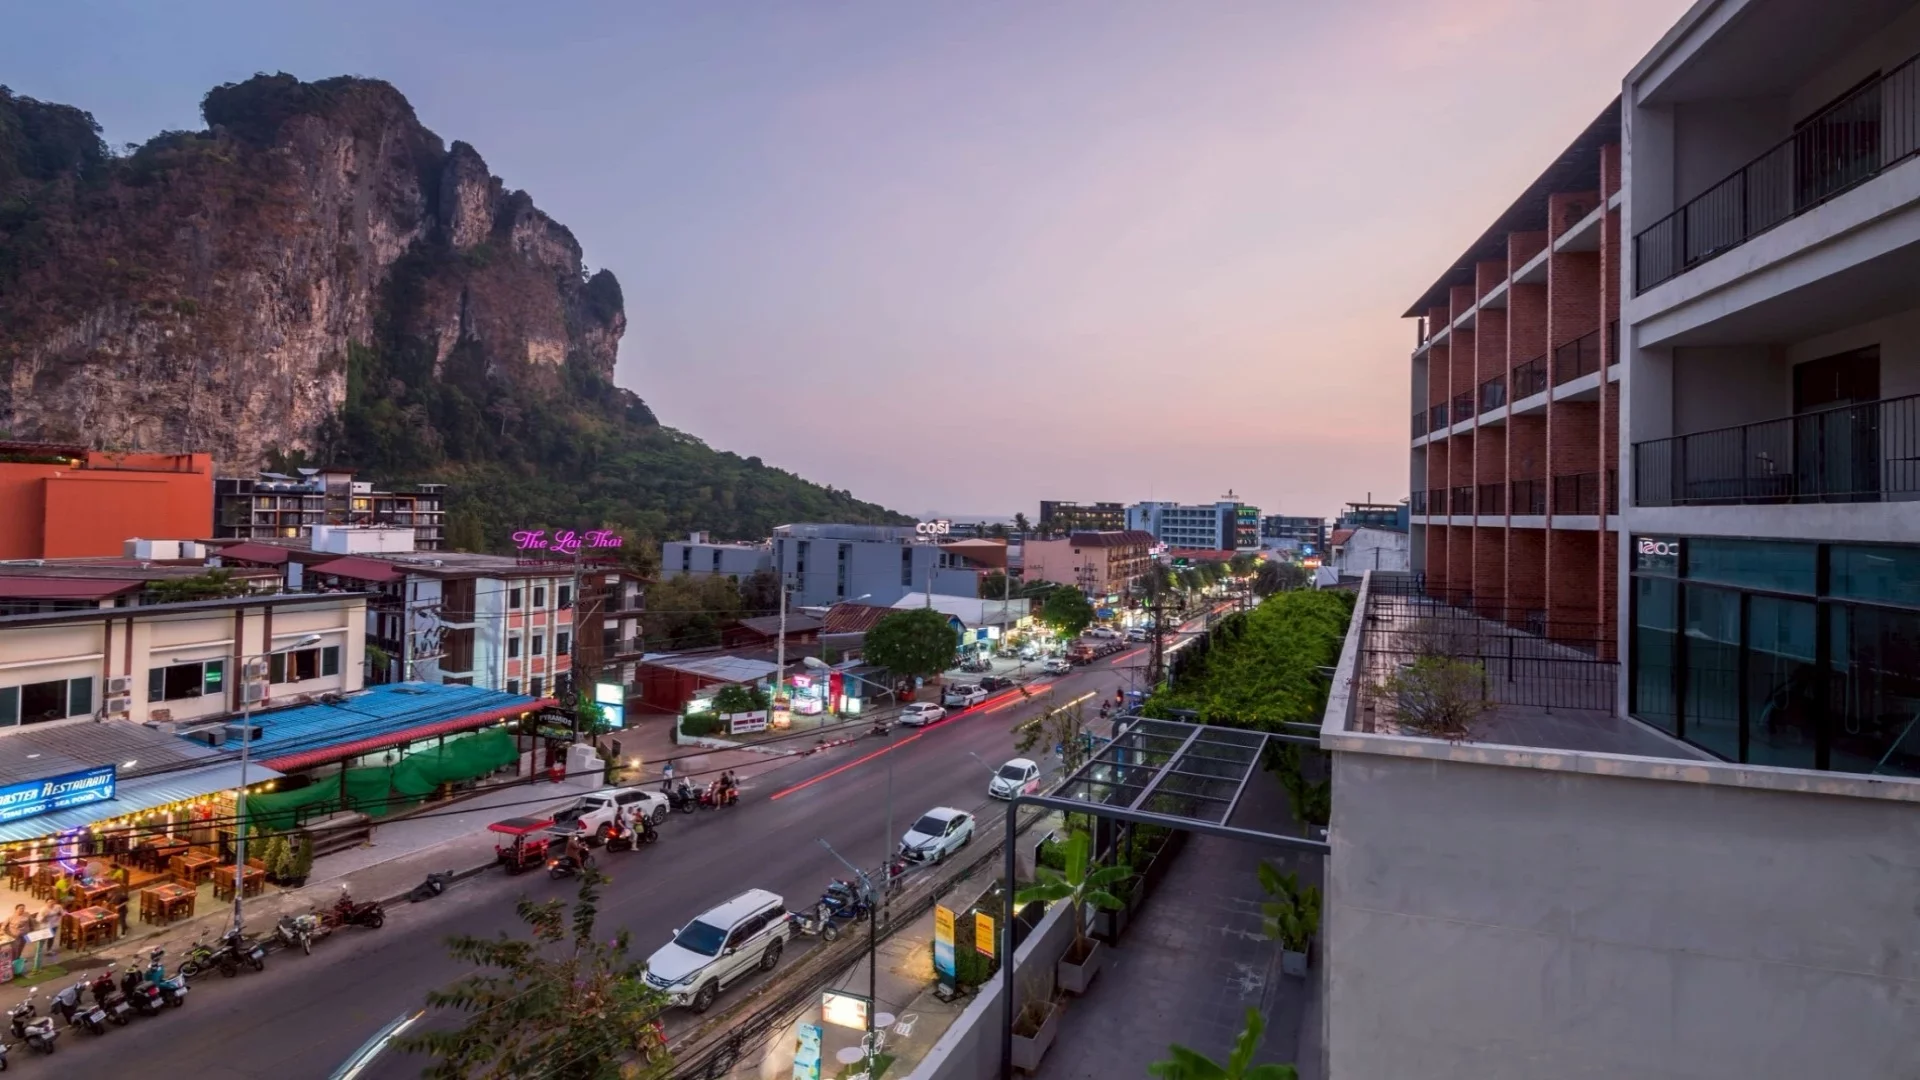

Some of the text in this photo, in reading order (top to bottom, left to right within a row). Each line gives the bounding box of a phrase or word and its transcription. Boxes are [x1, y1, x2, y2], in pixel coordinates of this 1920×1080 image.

[916, 520, 950, 534] COSI
[512, 530, 623, 555] The Lai Thai
[41, 774, 113, 797] RESTAURANT
[24, 804, 46, 815] FOOD
[55, 799, 71, 808] SEA
[72, 793, 95, 804] FOOD
